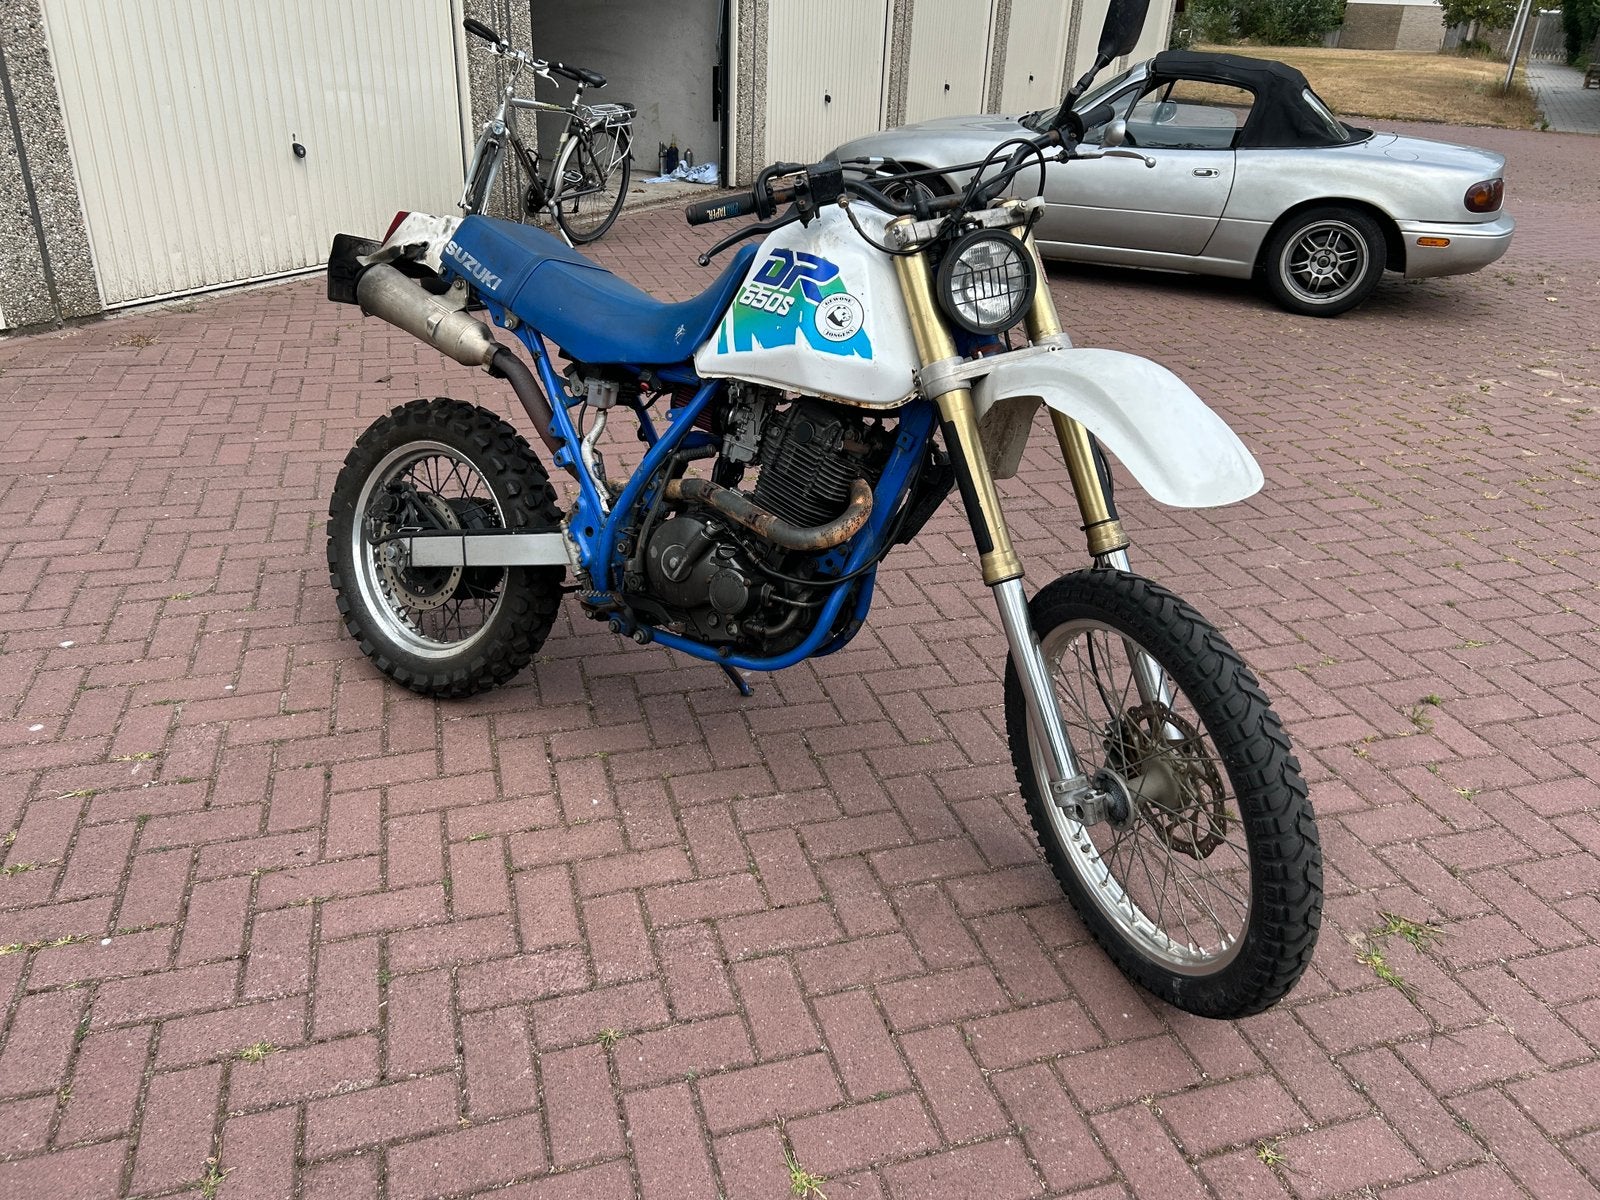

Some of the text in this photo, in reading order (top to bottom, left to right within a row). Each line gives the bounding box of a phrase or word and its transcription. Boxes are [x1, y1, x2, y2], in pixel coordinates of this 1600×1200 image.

[445, 240, 502, 290] SUZUKI
[753, 248, 839, 304] DR
[738, 286, 795, 317] 650S
